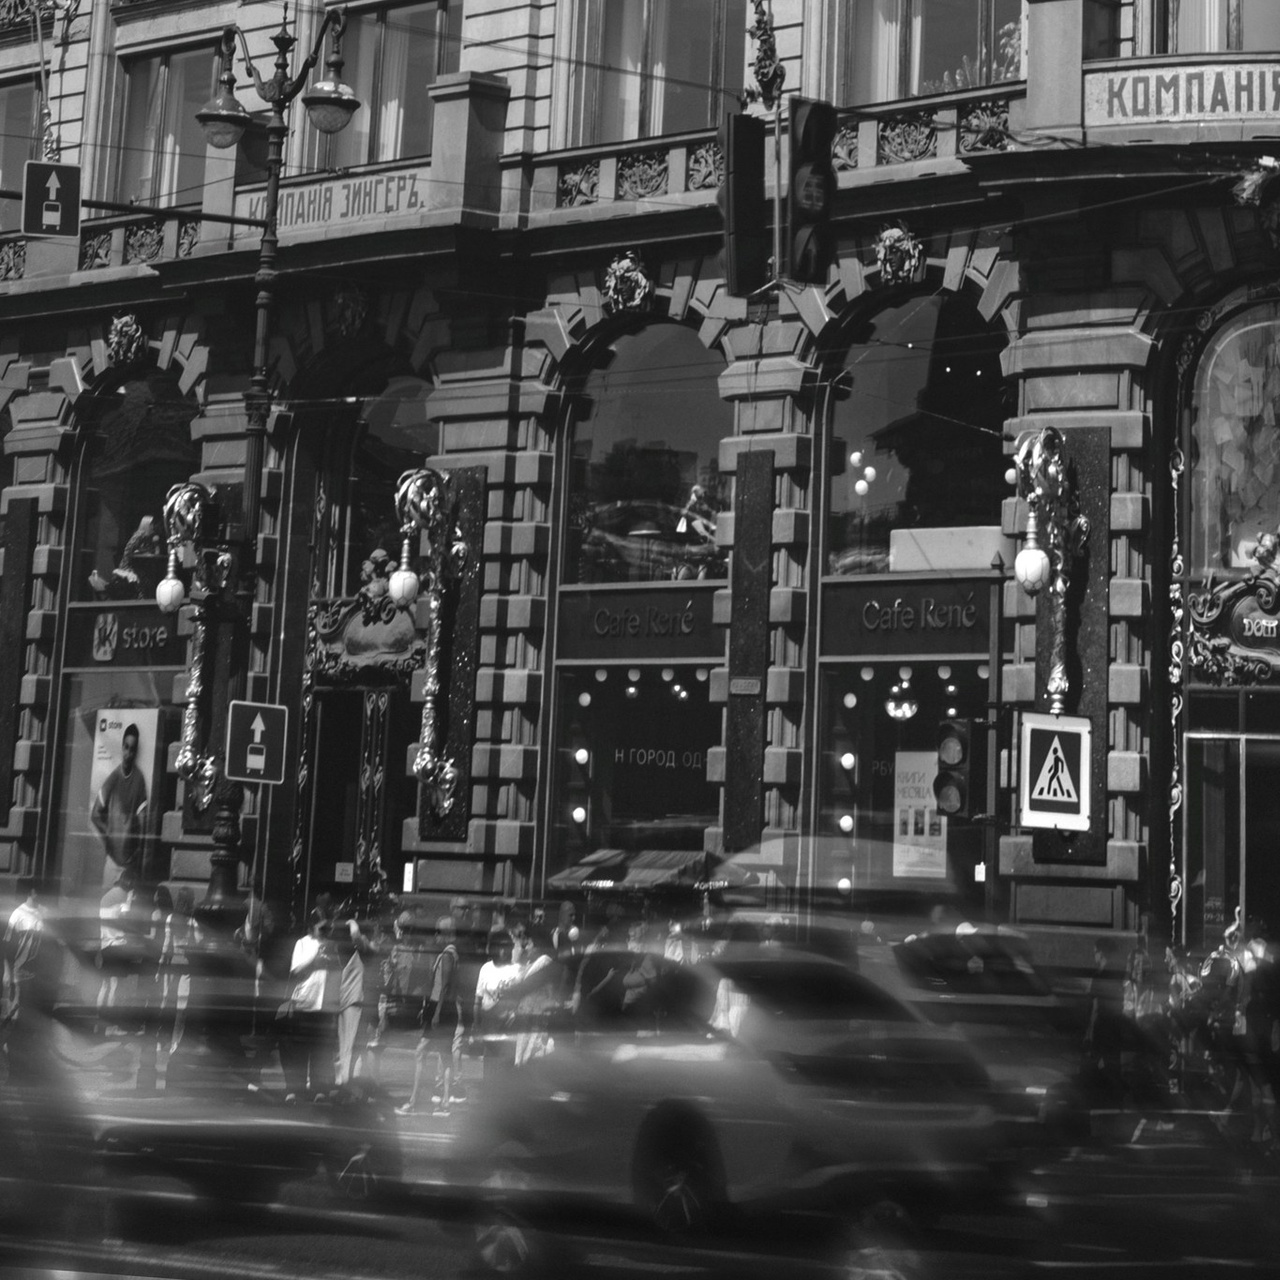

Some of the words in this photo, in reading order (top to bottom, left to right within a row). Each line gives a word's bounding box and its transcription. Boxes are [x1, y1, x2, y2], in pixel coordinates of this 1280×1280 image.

[247, 184, 333, 231] КПАНІЯ
[594, 606, 641, 637] Cafe
[645, 599, 695, 637] René
[862, 597, 915, 630] Cafe
[920, 590, 977, 628] René
[122, 622, 168, 649] store
[629, 748, 676, 769] ГОРОД
